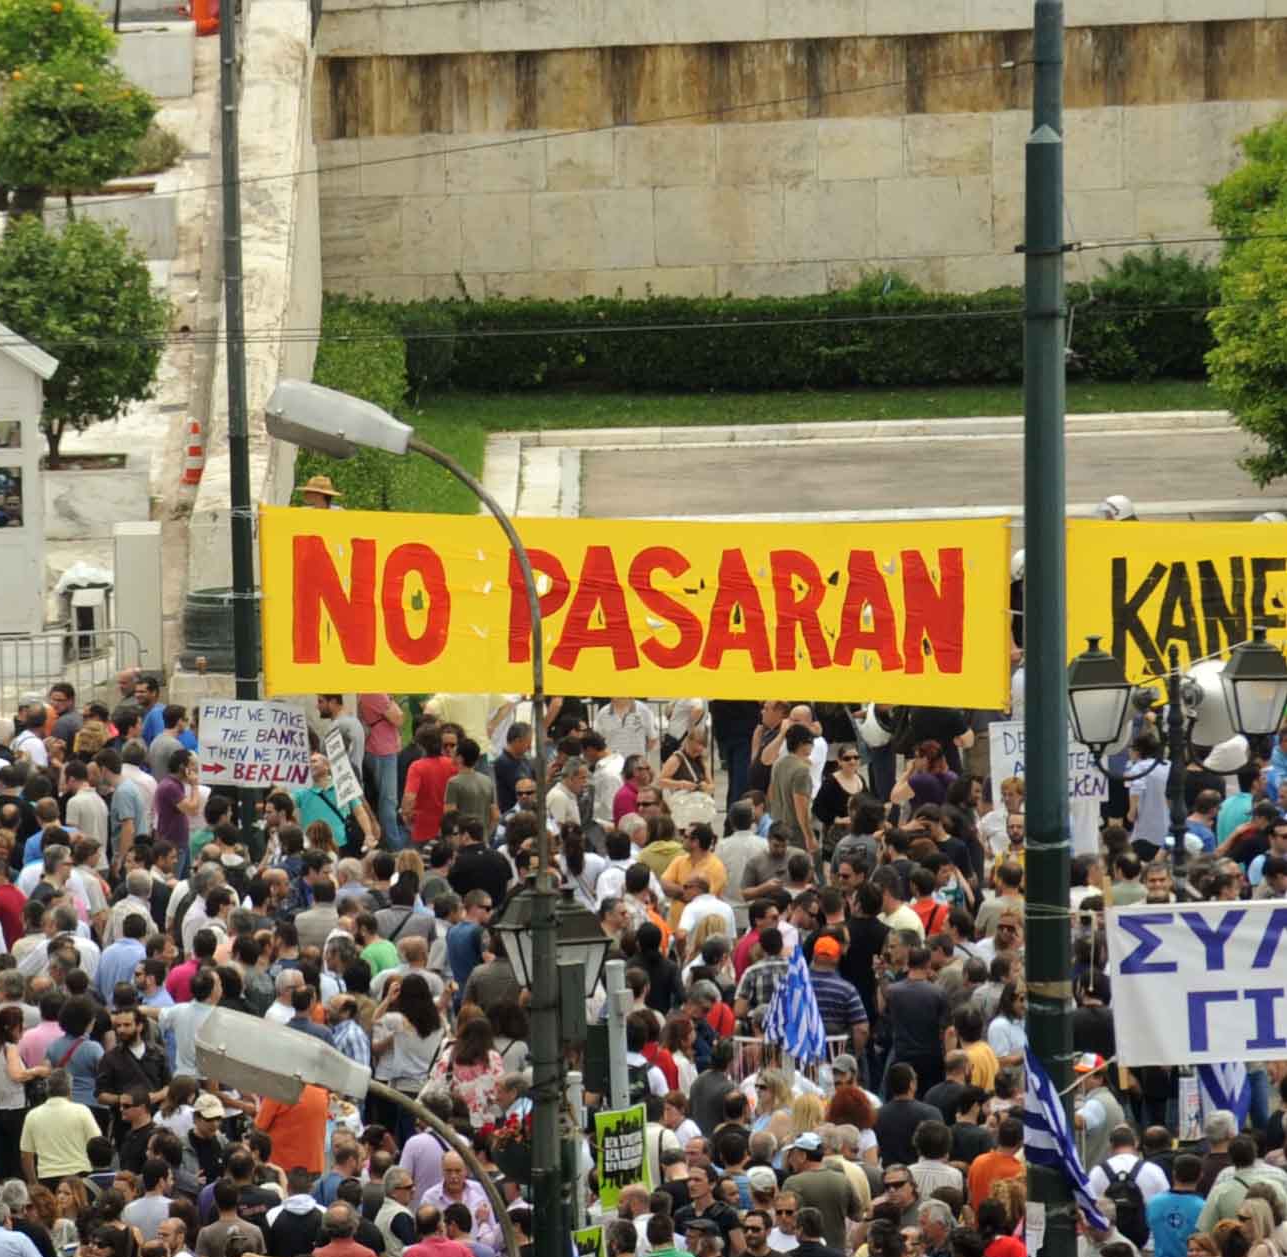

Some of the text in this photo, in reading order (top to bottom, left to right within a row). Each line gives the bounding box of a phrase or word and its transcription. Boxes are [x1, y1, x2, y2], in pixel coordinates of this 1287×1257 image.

[292, 535, 963, 674] NO PASARAN
[203, 703, 306, 730] FIRST WE TAKE
[221, 728, 306, 747] THE BANKS
[206, 745, 309, 764] THEN WE TAKE
[233, 763, 310, 785] BERLIN
